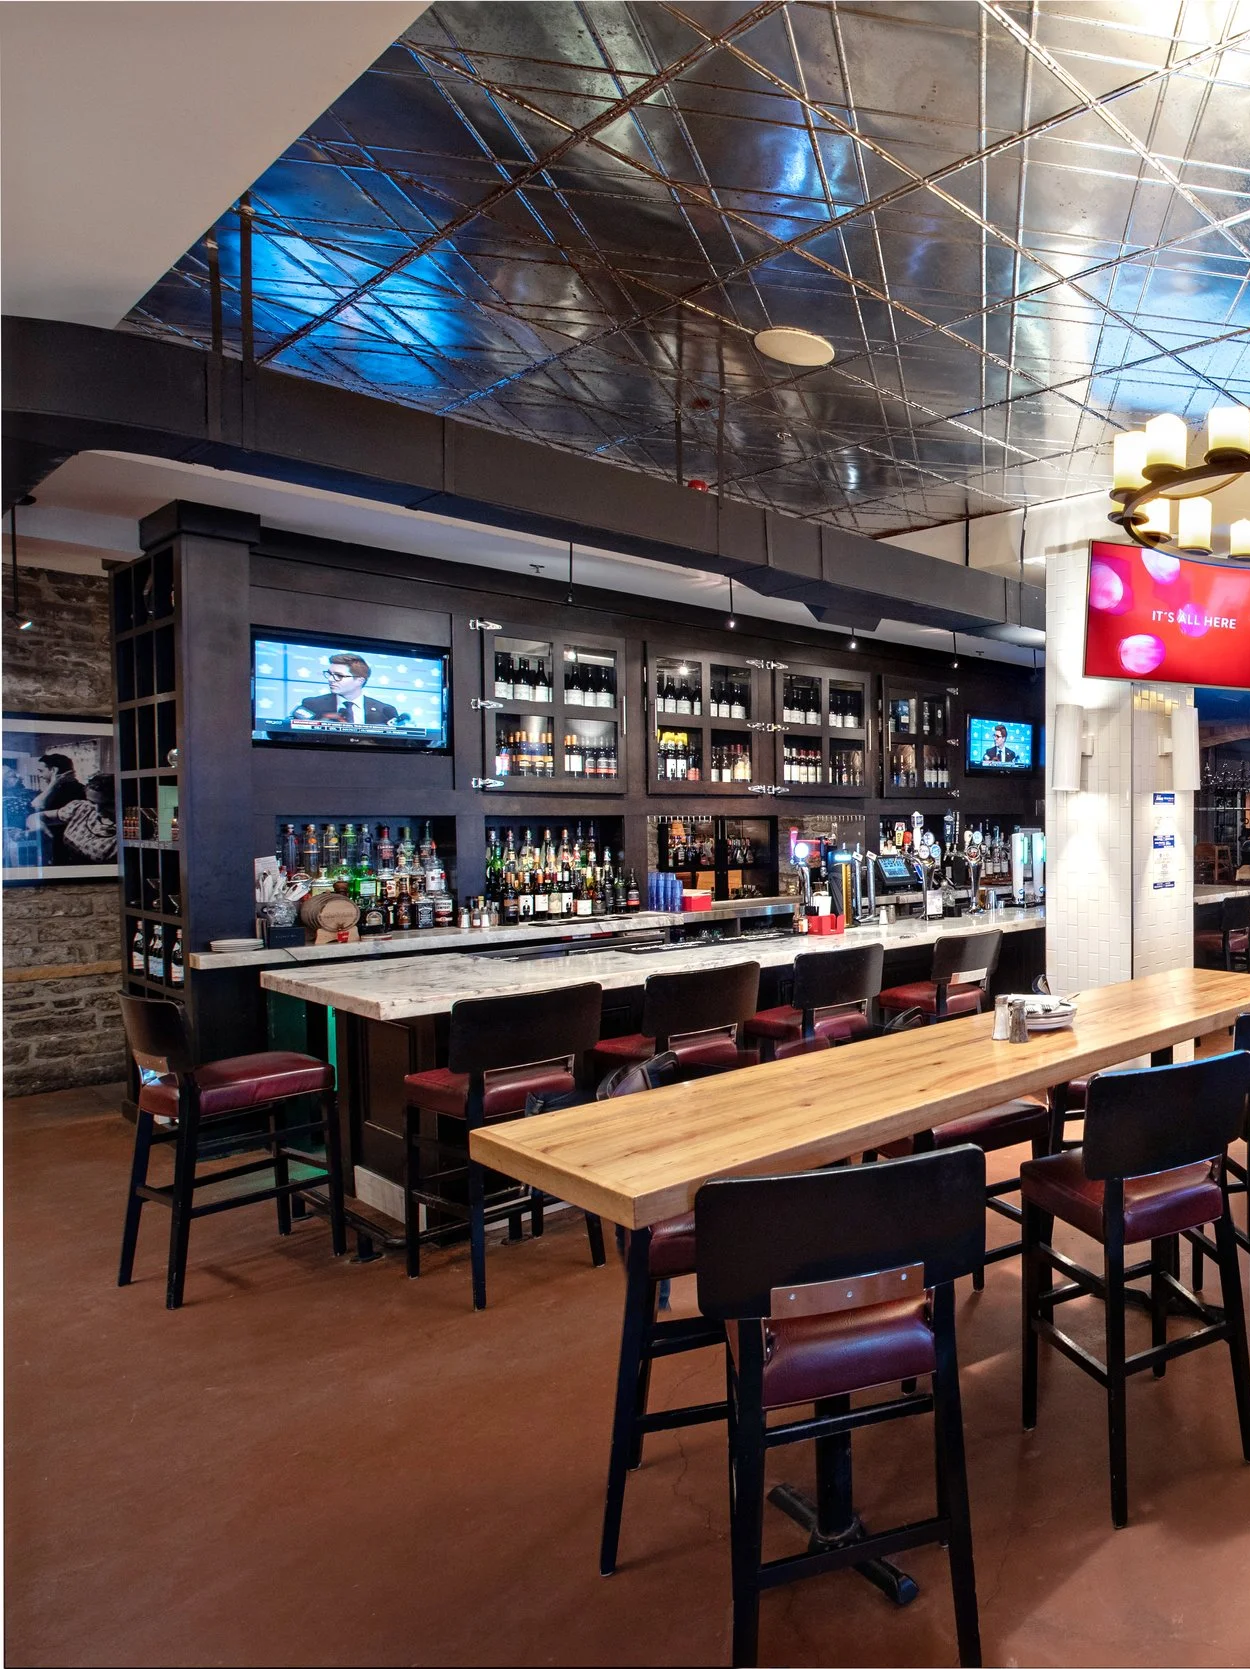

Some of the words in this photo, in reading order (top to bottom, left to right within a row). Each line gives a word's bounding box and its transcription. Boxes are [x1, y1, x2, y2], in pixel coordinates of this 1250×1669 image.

[1152, 610, 1174, 623] IT'S
[1177, 611, 1200, 626] ALL
[1204, 615, 1236, 629] HERE
